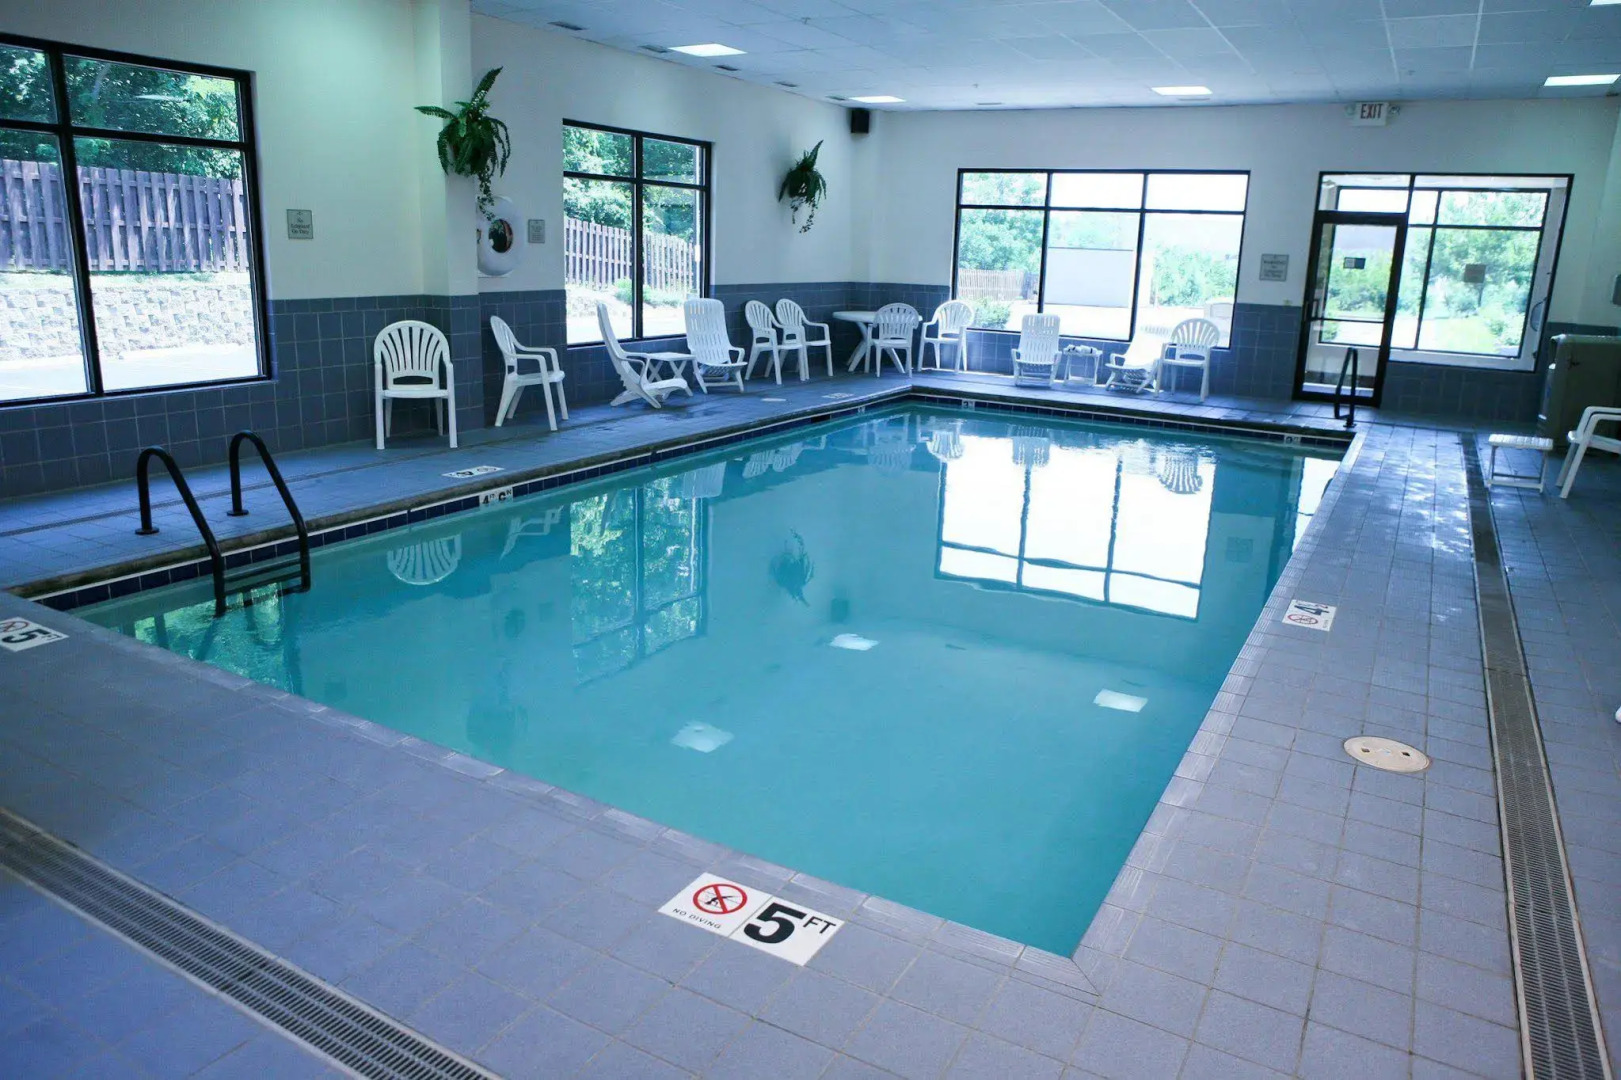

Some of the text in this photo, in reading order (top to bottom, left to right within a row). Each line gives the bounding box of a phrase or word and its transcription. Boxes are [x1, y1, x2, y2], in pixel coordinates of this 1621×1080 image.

[1360, 103, 1383, 119] EXIT
[2, 629, 51, 643] 5
[673, 908, 722, 930] NO DIVING
[743, 902, 837, 944] 5 FT
